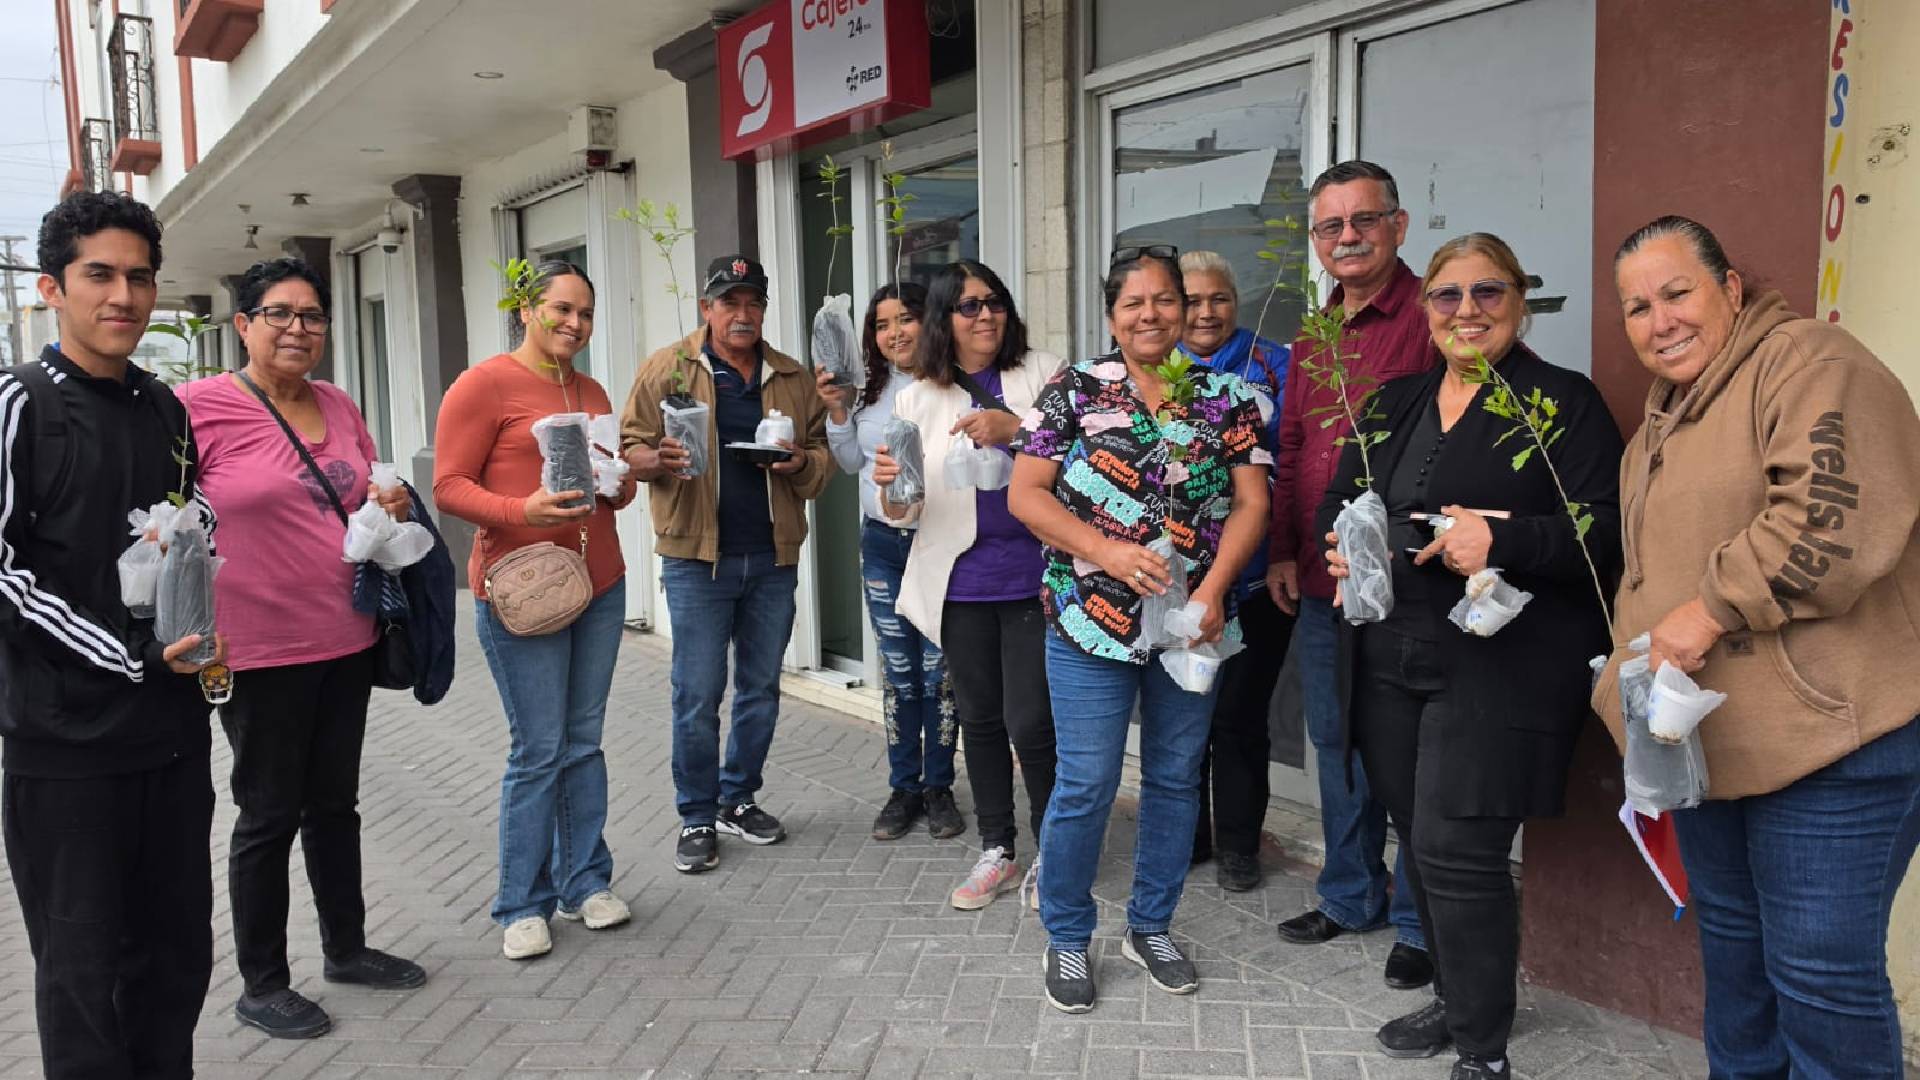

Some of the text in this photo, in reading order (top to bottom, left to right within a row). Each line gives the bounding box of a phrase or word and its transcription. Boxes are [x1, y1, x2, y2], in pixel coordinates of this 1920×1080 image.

[801, 0, 869, 31] Caje
[847, 16, 863, 39] 24
[860, 65, 881, 84] RED
